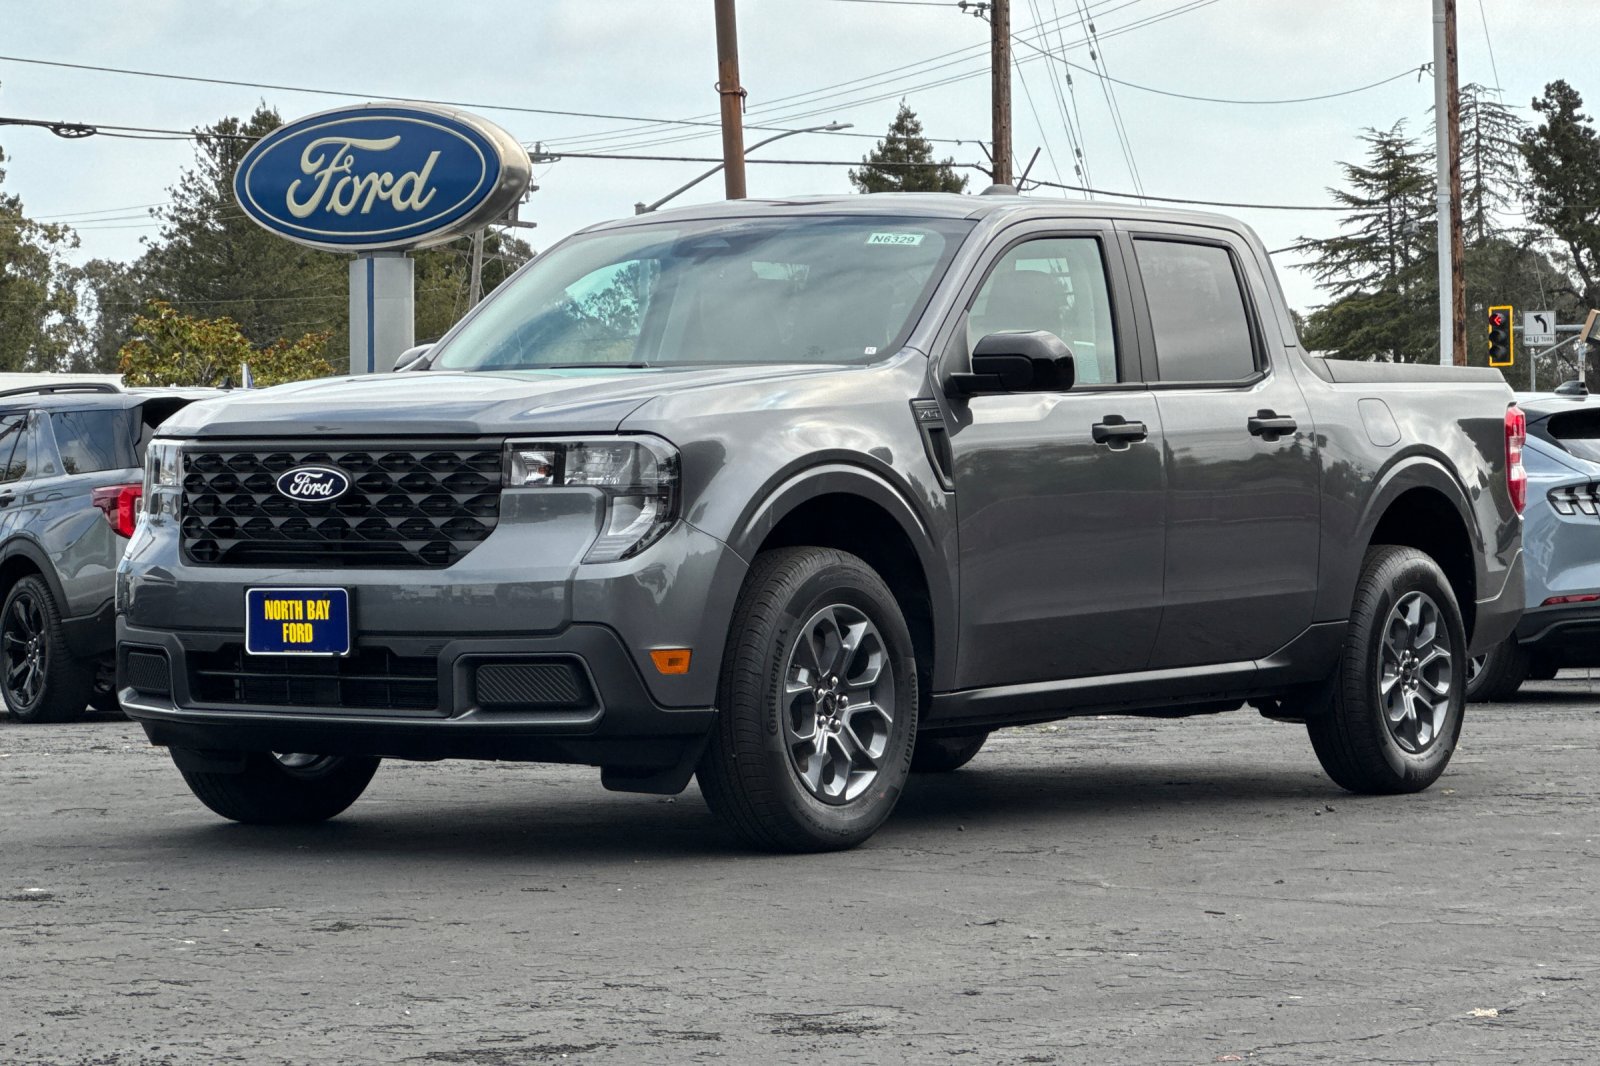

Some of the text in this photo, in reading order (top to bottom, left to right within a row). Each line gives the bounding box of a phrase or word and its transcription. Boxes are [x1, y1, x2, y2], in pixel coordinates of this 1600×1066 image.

[286, 135, 441, 218] Ford
[872, 235, 915, 244] N6329
[1533, 335, 1539, 343] U
[290, 472, 334, 495] Ford
[264, 600, 330, 620] NORTH BAY
[282, 623, 313, 643] FORD
